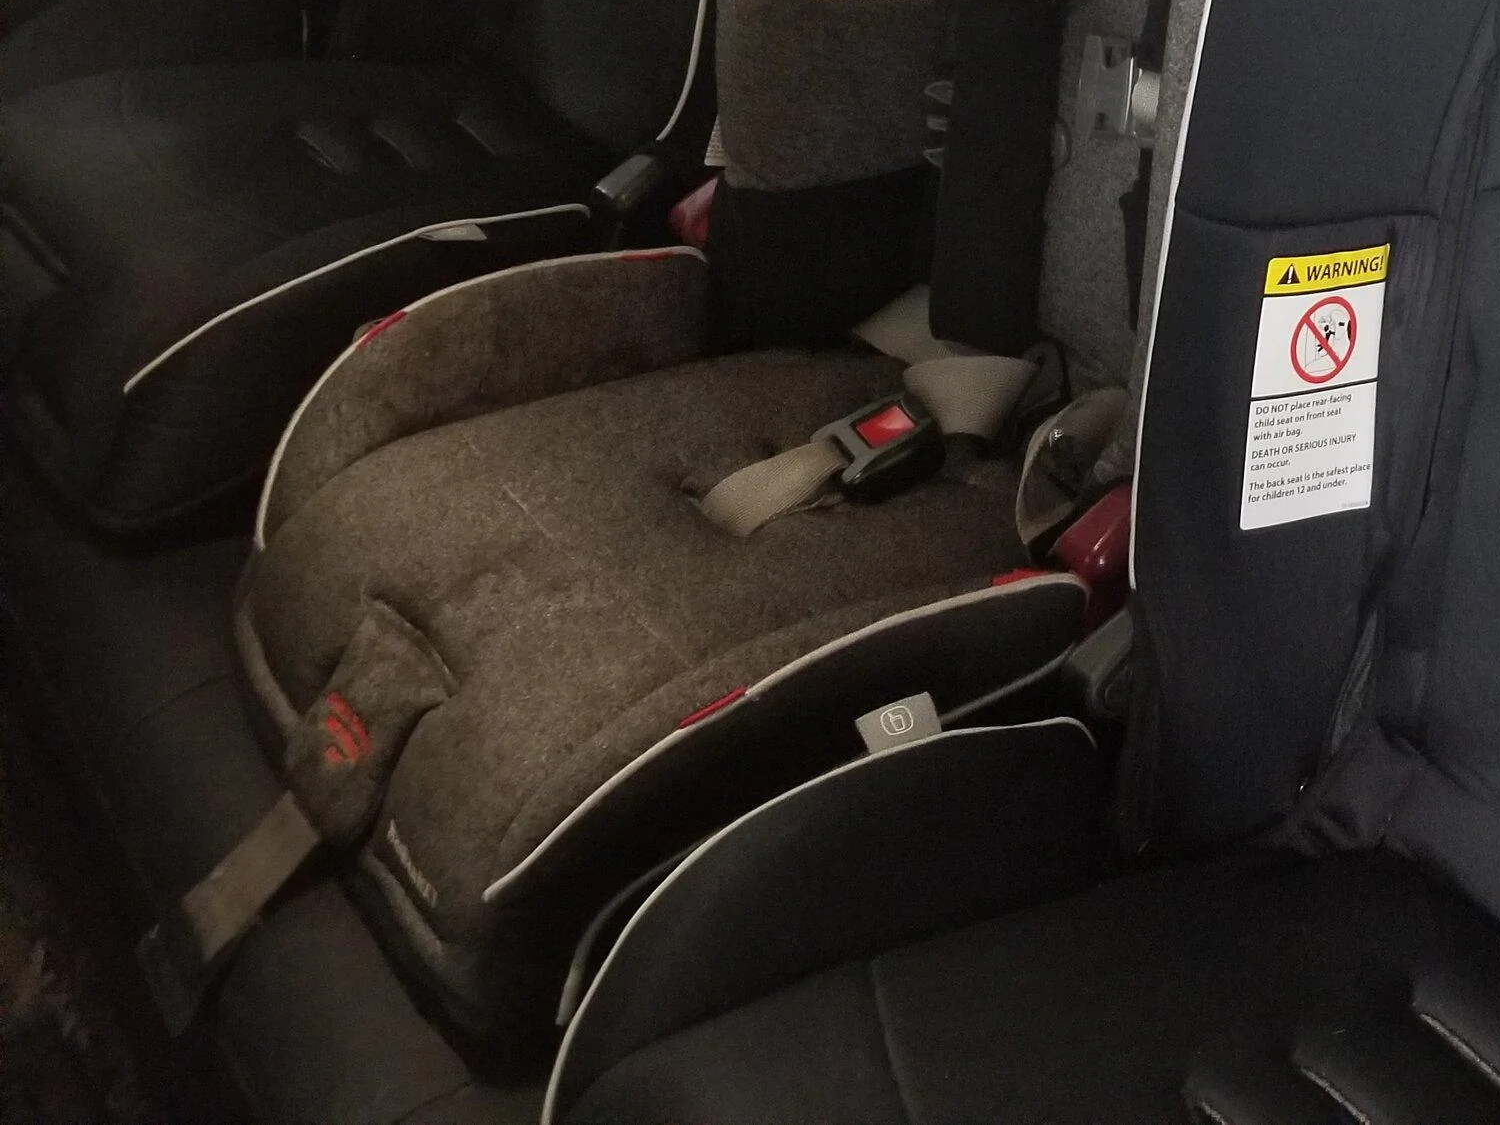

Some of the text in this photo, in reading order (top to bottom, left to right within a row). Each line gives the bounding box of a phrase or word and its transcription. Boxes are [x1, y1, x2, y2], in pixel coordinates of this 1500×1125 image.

[1306, 255, 1384, 282] WARNING!
[1254, 418, 1275, 428] child
[1277, 417, 1293, 425] seat
[1306, 411, 1325, 420] front
[1327, 408, 1342, 416] seat
[1256, 406, 1270, 415] DO
[1271, 403, 1289, 413] NOT
[1290, 401, 1310, 412] place
[1253, 428, 1303, 441] with air bag.
[1251, 434, 1357, 459] DEATH OR SERIOUS INJURY
[1250, 459, 1290, 471] can occur.
[1249, 482, 1265, 491] The
[1266, 477, 1285, 488] back
[1287, 476, 1303, 485] seat
[1312, 471, 1325, 480] the
[1326, 466, 1349, 477] safest
[1350, 463, 1371, 474] place
[1248, 479, 1347, 503] for children 12 and under.
